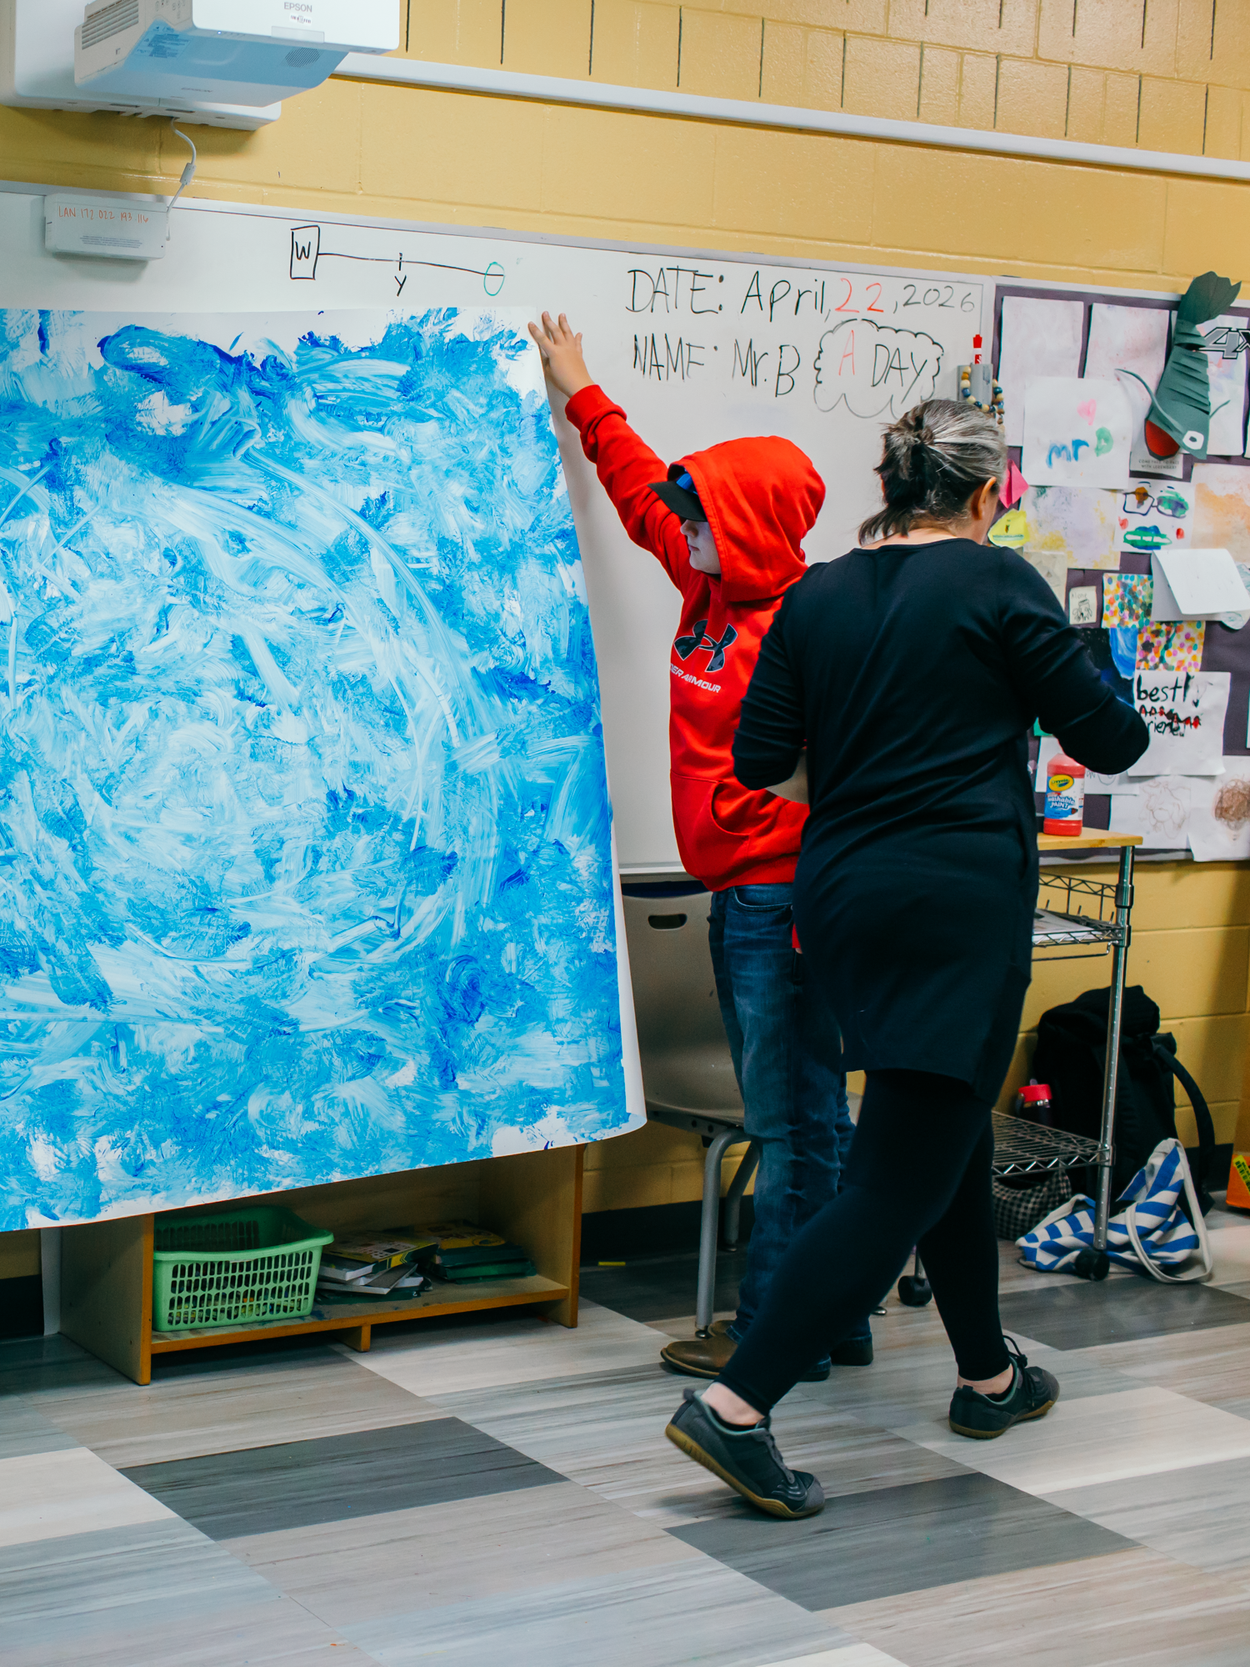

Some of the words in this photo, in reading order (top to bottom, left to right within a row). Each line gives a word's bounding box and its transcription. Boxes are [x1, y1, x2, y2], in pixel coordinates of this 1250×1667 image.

[283, 2, 313, 13] EPSON
[58, 205, 77, 218] LAN
[98, 209, 116, 220] 022
[294, 240, 311, 261] W
[625, 265, 725, 315] DATE:
[839, 329, 856, 376] A
[871, 343, 928, 404] DAY
